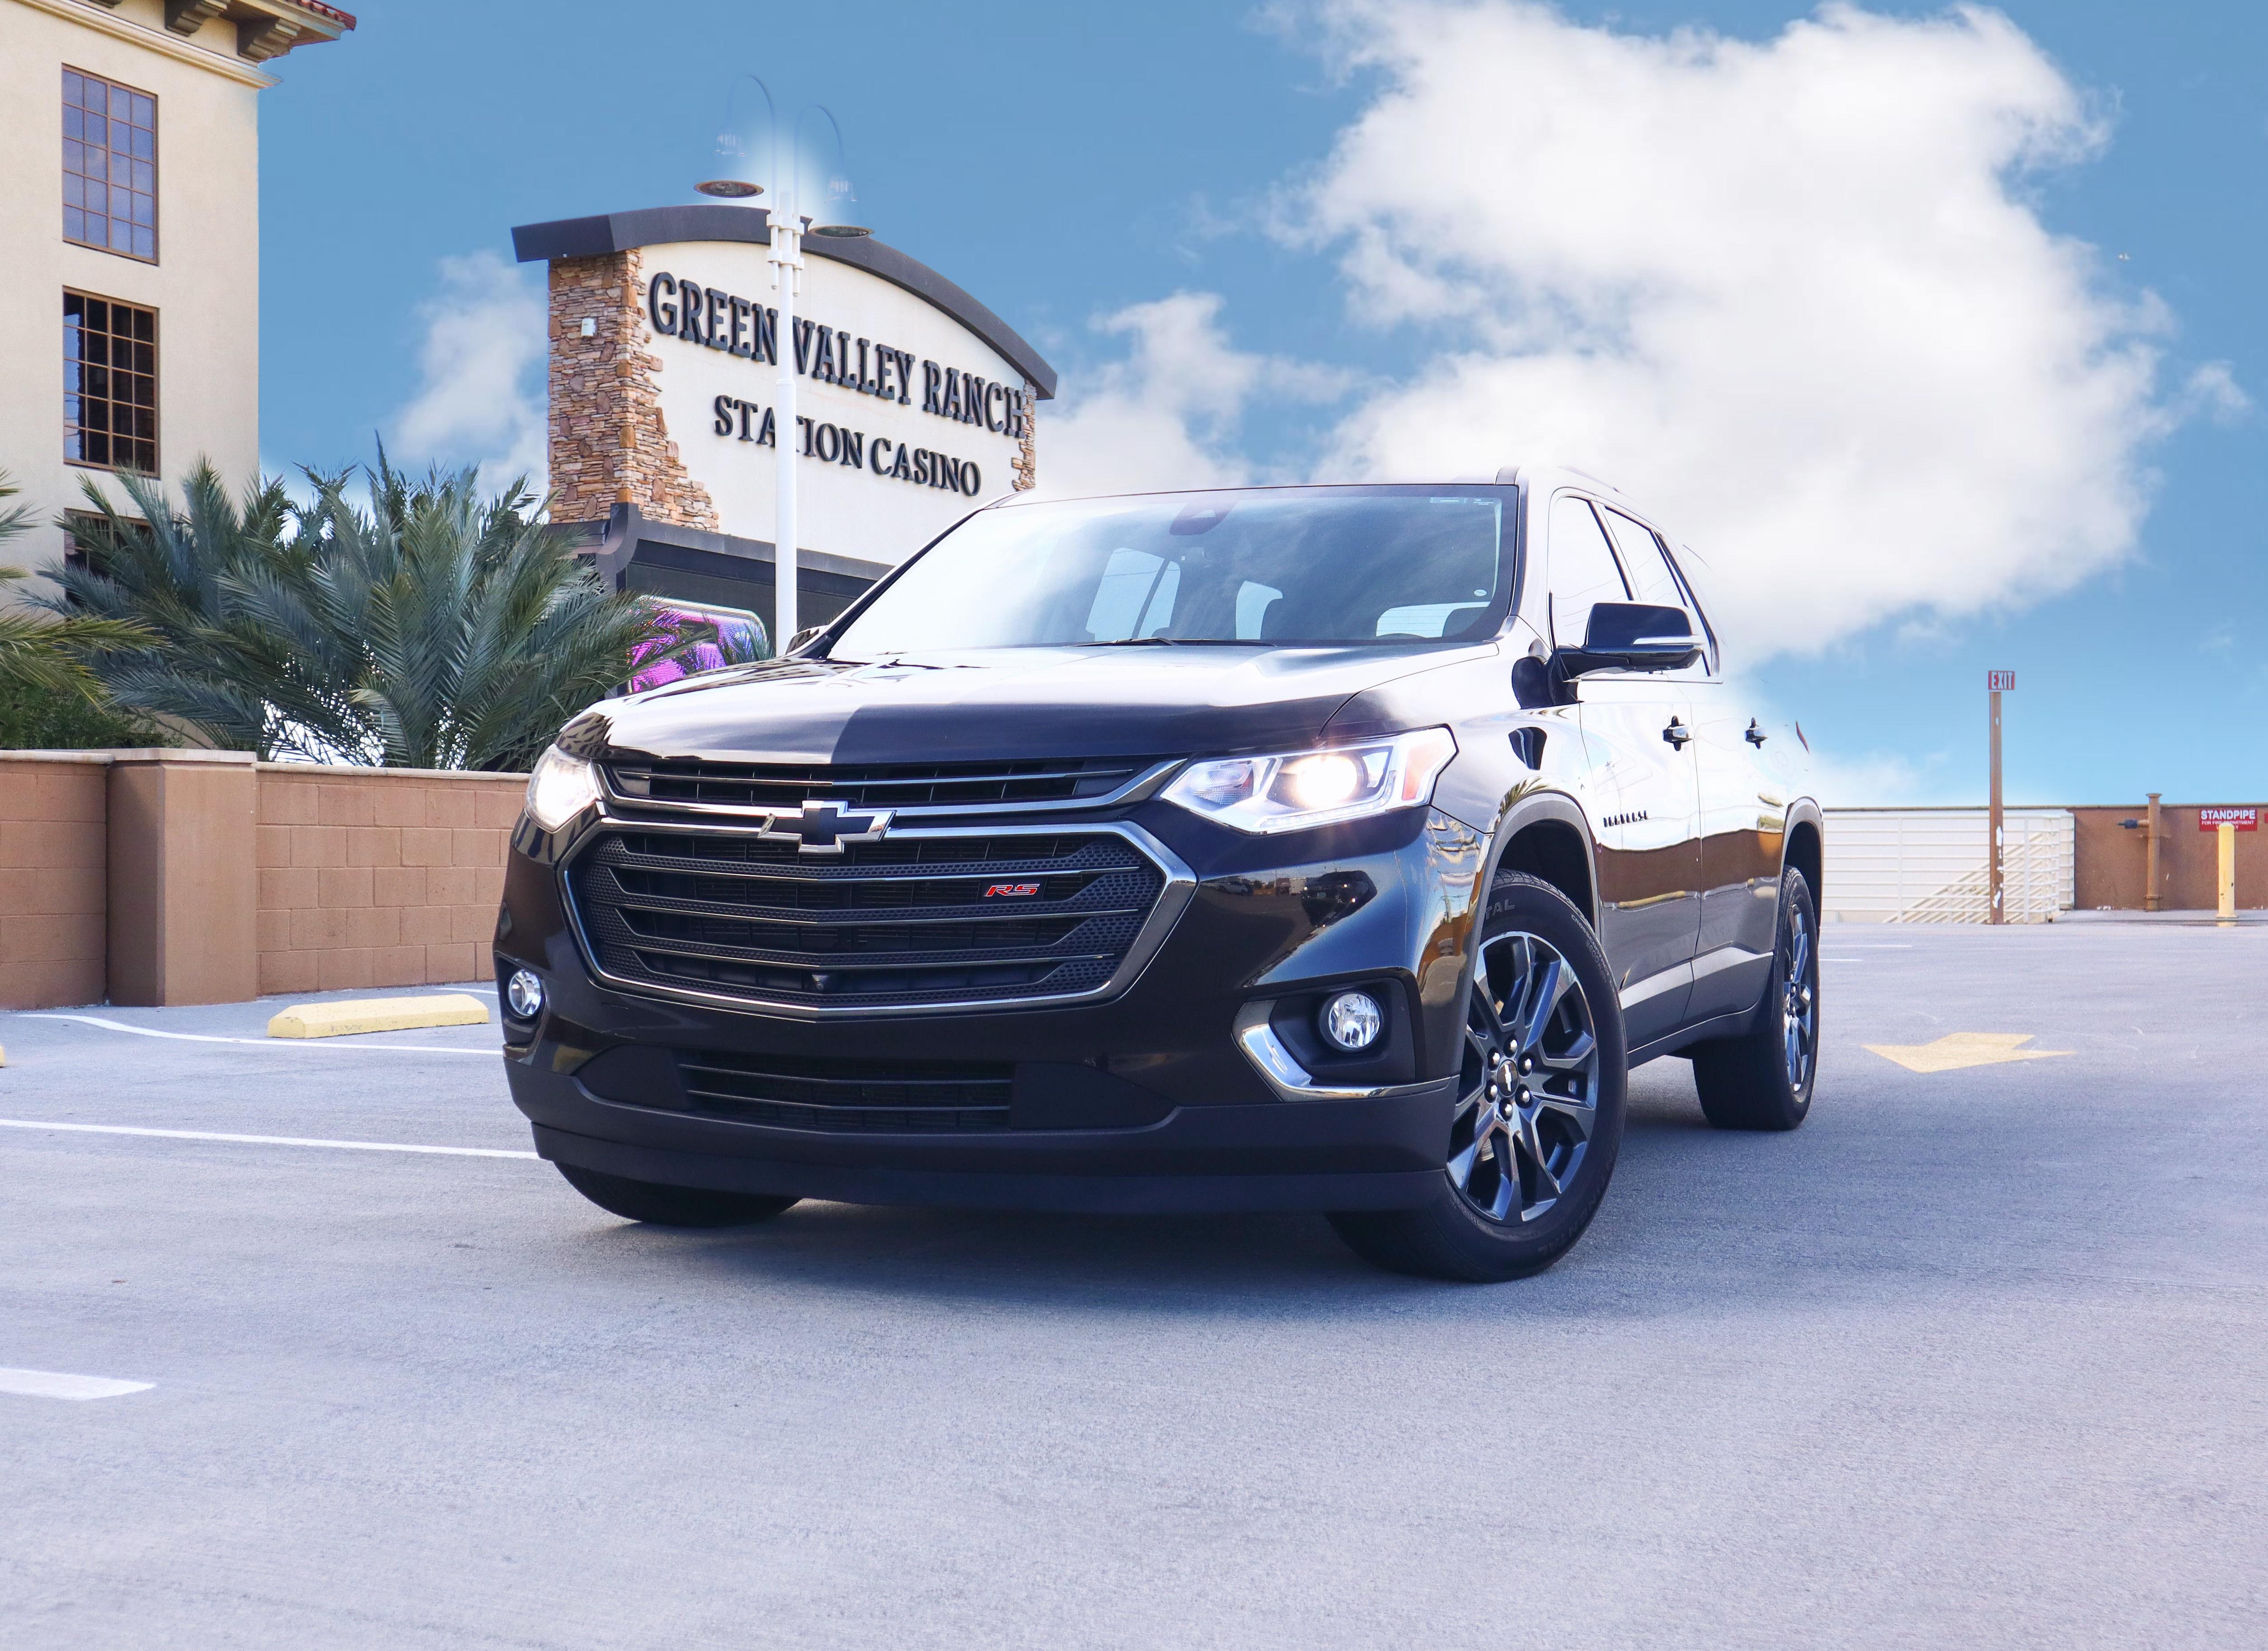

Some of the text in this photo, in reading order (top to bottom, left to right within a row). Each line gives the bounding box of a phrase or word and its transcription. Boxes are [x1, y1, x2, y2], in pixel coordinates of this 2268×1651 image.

[649, 272, 1025, 439] GREEN VALLEY RANCH
[870, 437, 981, 497] CASINO
[1991, 672, 2013, 689] EXIT
[2201, 809, 2256, 820] STANDPIPE
[984, 884, 1040, 897] RS
